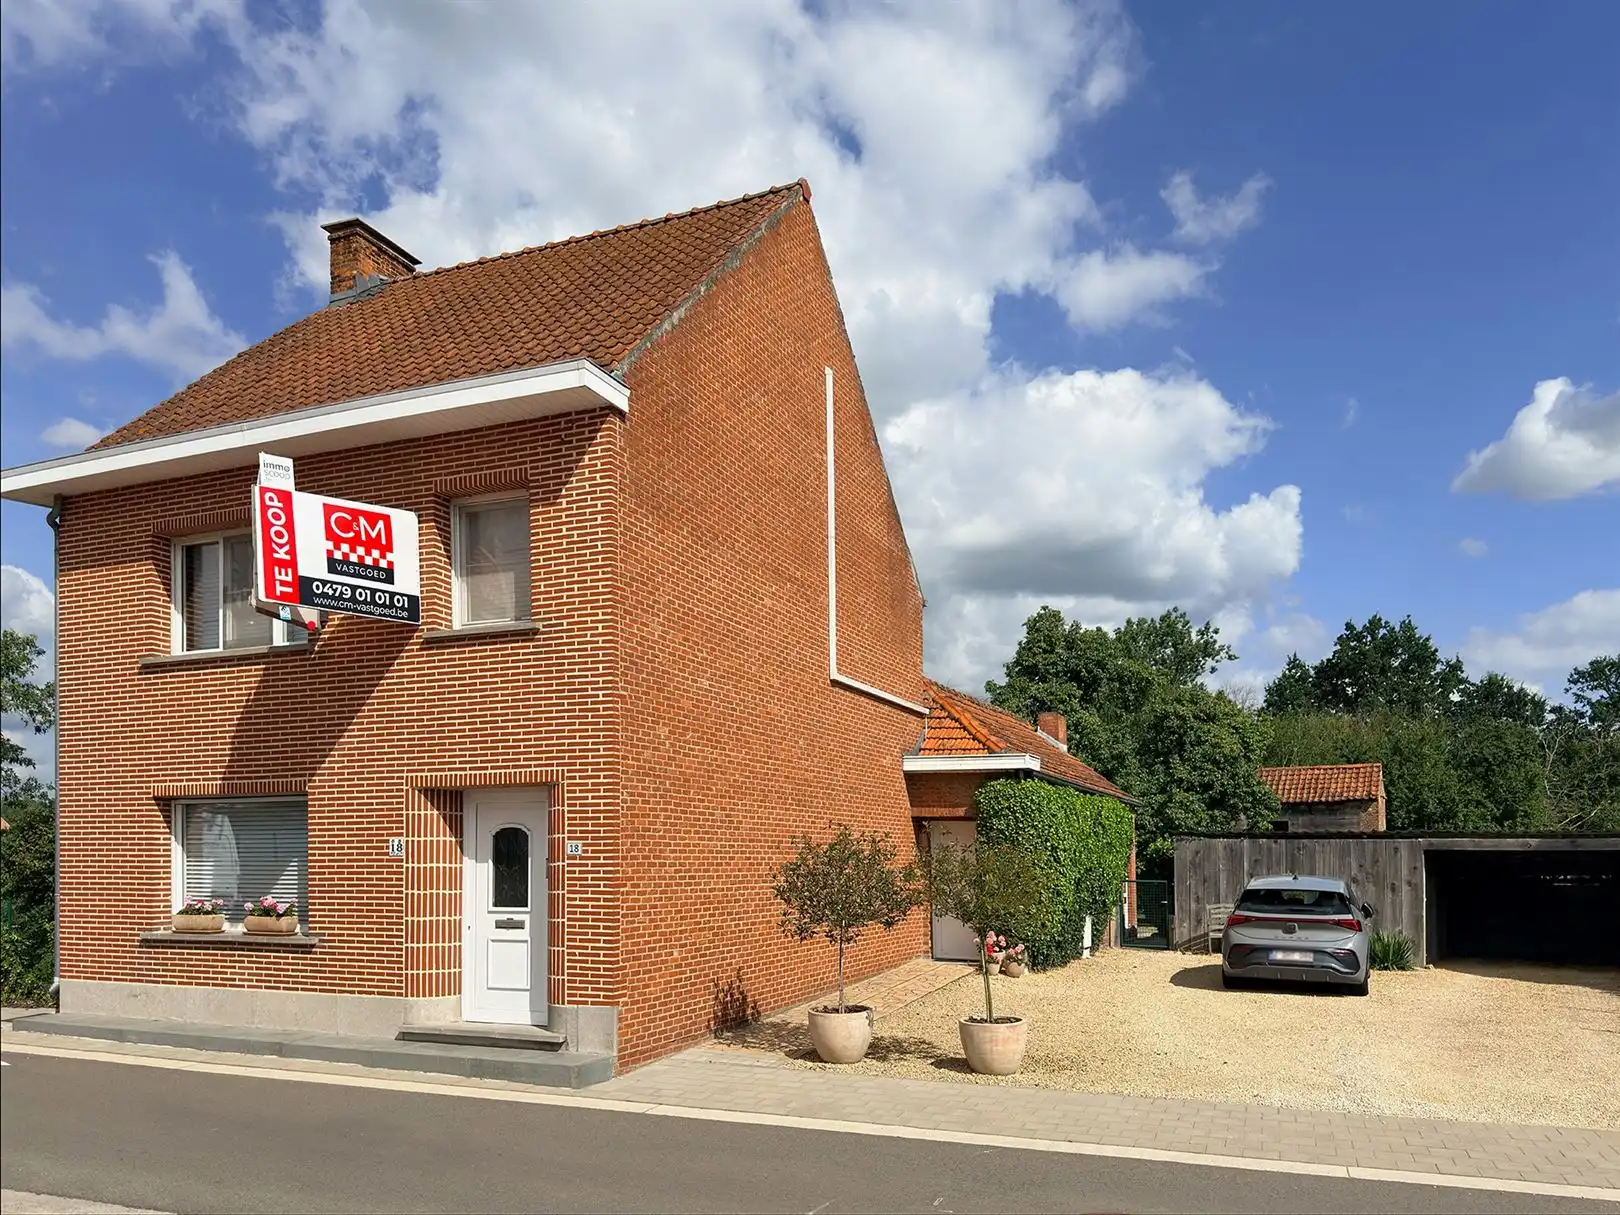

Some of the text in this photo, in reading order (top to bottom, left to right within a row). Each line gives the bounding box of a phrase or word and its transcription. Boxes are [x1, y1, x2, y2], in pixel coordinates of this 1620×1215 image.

[263, 460, 290, 472] immo
[265, 492, 291, 560] KOOP
[335, 562, 386, 579] VASTGOED
[274, 566, 293, 596] TE
[312, 581, 409, 608] 0479 01 01 01
[313, 596, 409, 618] www.cm-vastgoed.be
[391, 843, 403, 852] 18
[569, 844, 579, 853] 18
